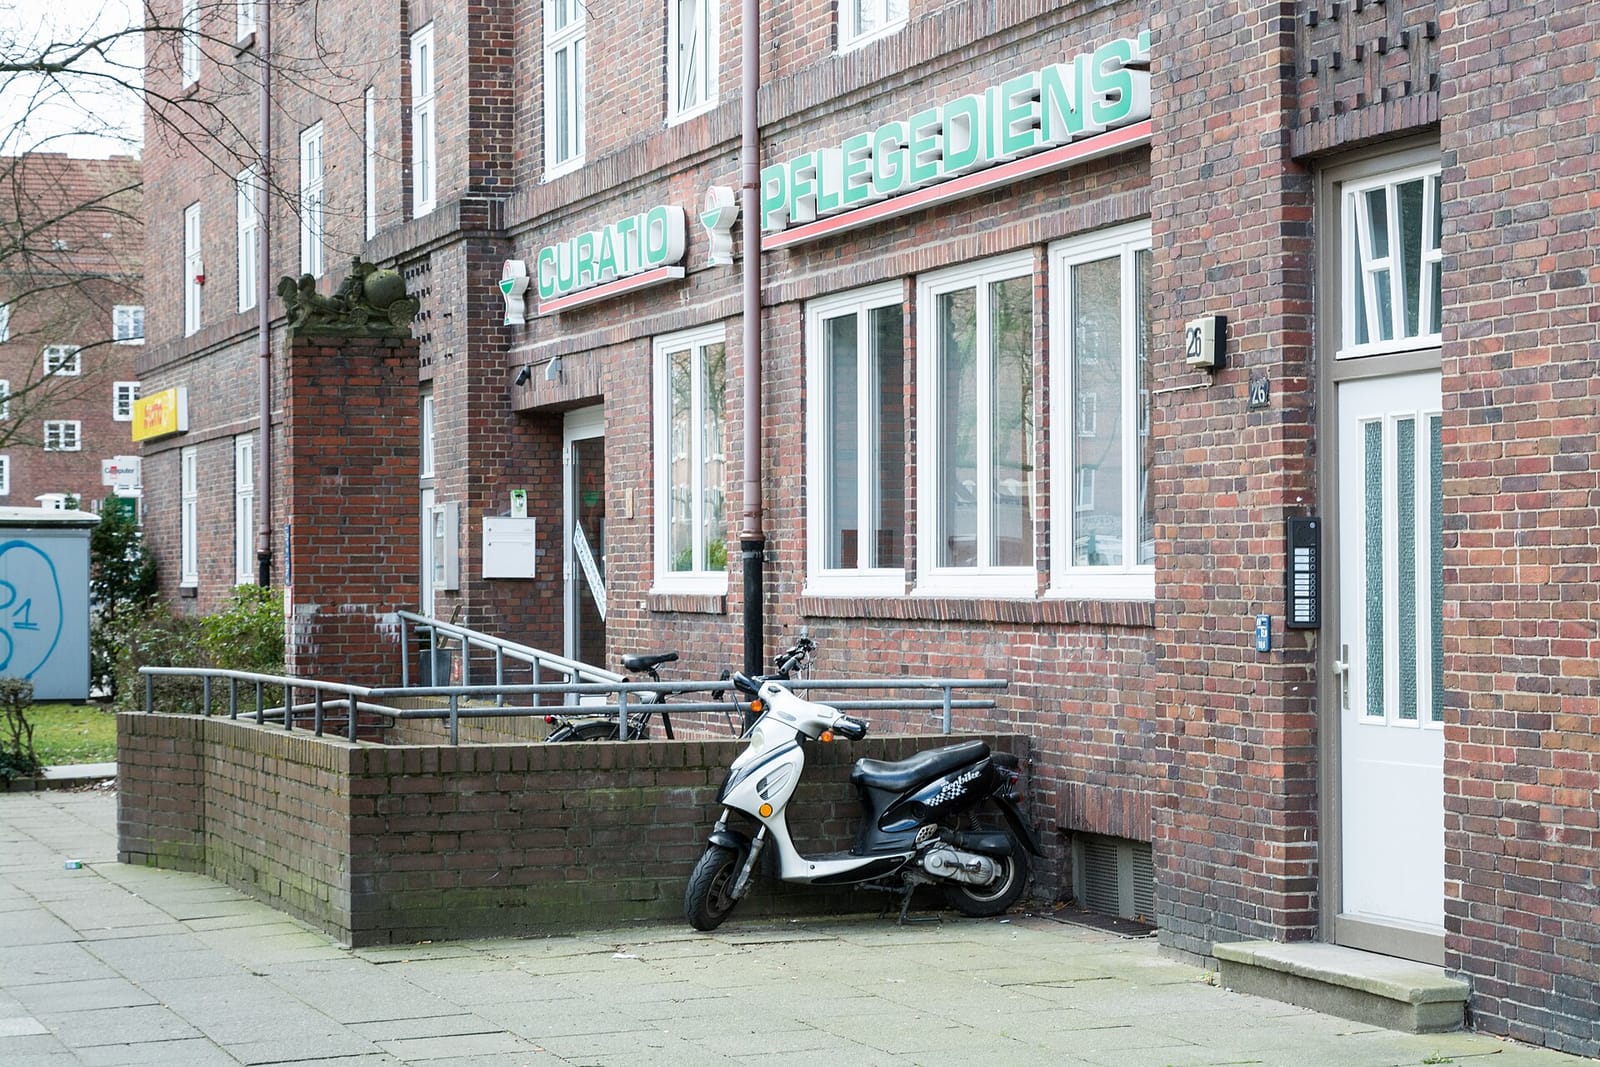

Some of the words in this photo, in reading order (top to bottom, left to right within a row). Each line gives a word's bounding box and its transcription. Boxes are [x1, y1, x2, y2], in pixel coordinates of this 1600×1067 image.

[537, 205, 670, 300] CURATIO
[1186, 327, 1202, 358] 26
[1251, 383, 1266, 405] 26
